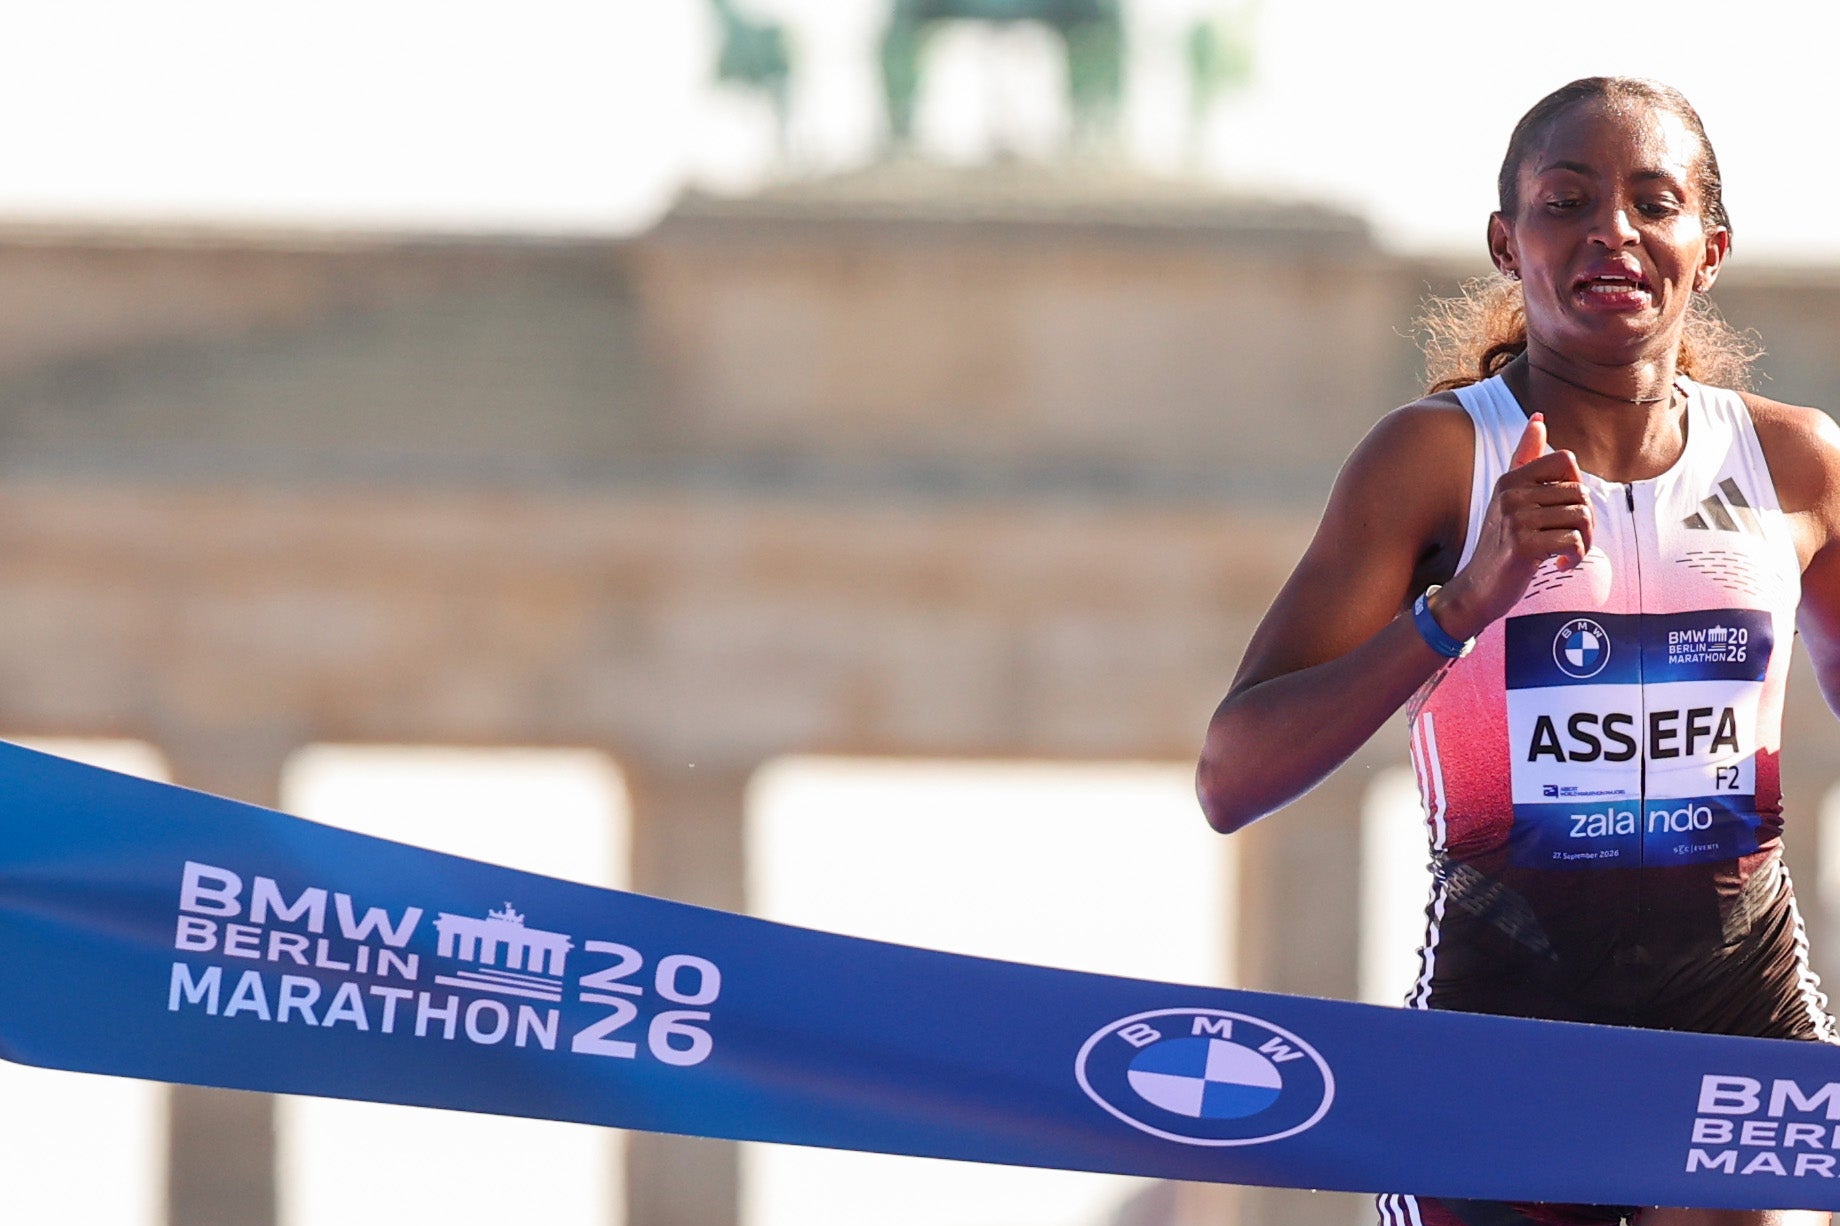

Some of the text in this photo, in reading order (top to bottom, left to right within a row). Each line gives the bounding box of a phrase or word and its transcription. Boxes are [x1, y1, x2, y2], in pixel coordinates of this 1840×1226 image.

[1561, 622, 1603, 639] BMW
[1668, 628, 1707, 645] BMW
[1727, 628, 1748, 645] 20
[1668, 643, 1707, 655] BERLIN
[1668, 652, 1727, 665] MARATHON
[1726, 646, 1747, 662] 26
[1527, 707, 1740, 763] ASSEFA
[1715, 765, 1740, 790] F2
[1570, 803, 1713, 838] zalando
[1599, 849, 1620, 859] 2026
[179, 860, 424, 948] BMW
[174, 915, 421, 981] BERLIN
[578, 940, 722, 1006] 20
[167, 962, 560, 1051] MARATHON
[570, 992, 714, 1067] 26
[1117, 1016, 1305, 1063] BMW
